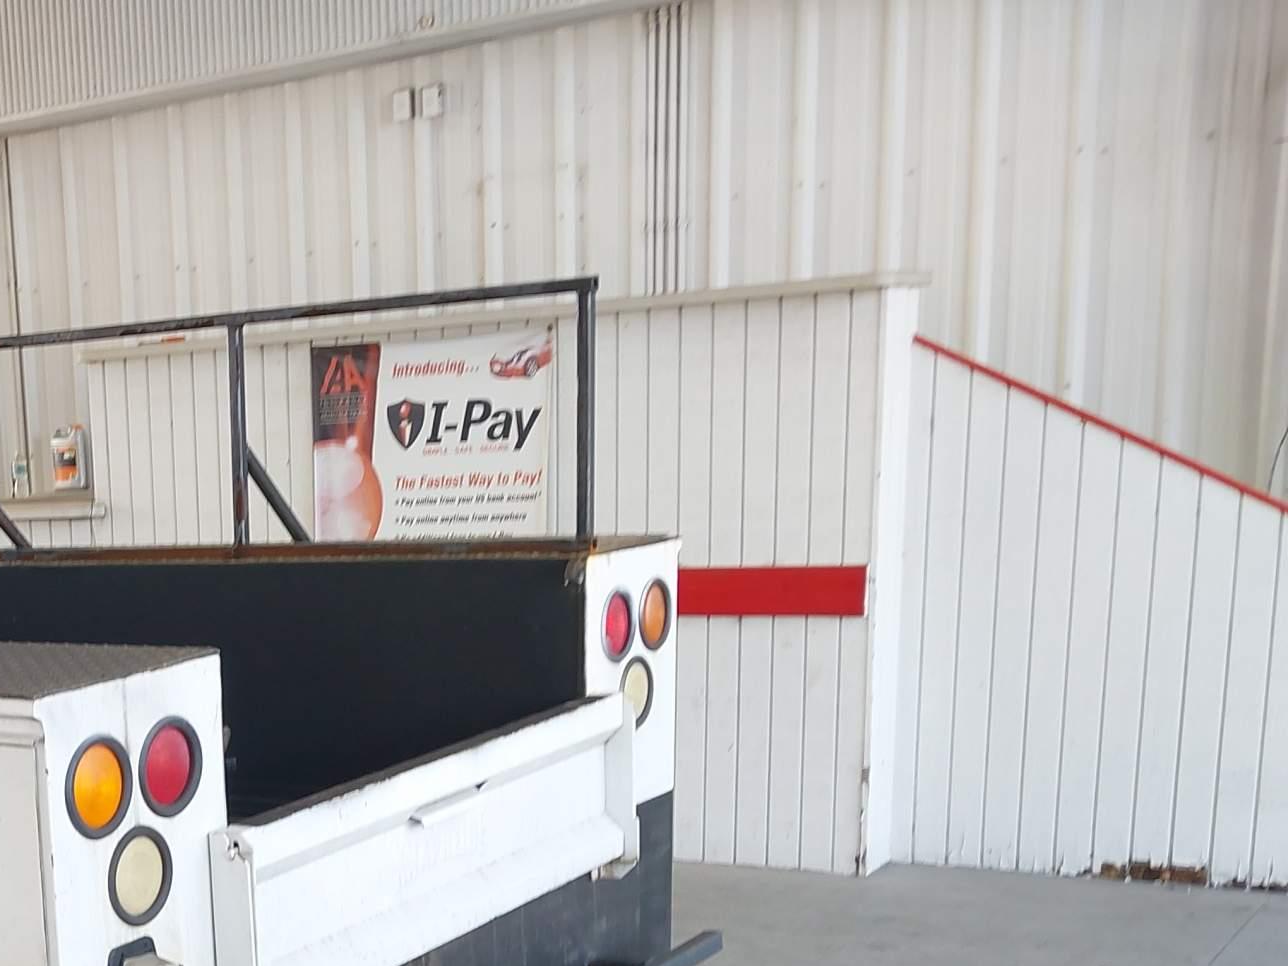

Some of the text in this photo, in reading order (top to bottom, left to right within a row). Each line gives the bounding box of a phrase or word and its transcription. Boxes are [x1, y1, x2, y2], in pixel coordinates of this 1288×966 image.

[425, 399, 542, 450] I-Pay
[395, 469, 543, 490] The Fastest Way to Pay!
[400, 496, 414, 508] Pay
[416, 495, 438, 505] online
[439, 495, 456, 505] from
[457, 495, 474, 506] your
[487, 493, 505, 502] bank
[400, 512, 528, 527] Pay online anytime from anywhere
